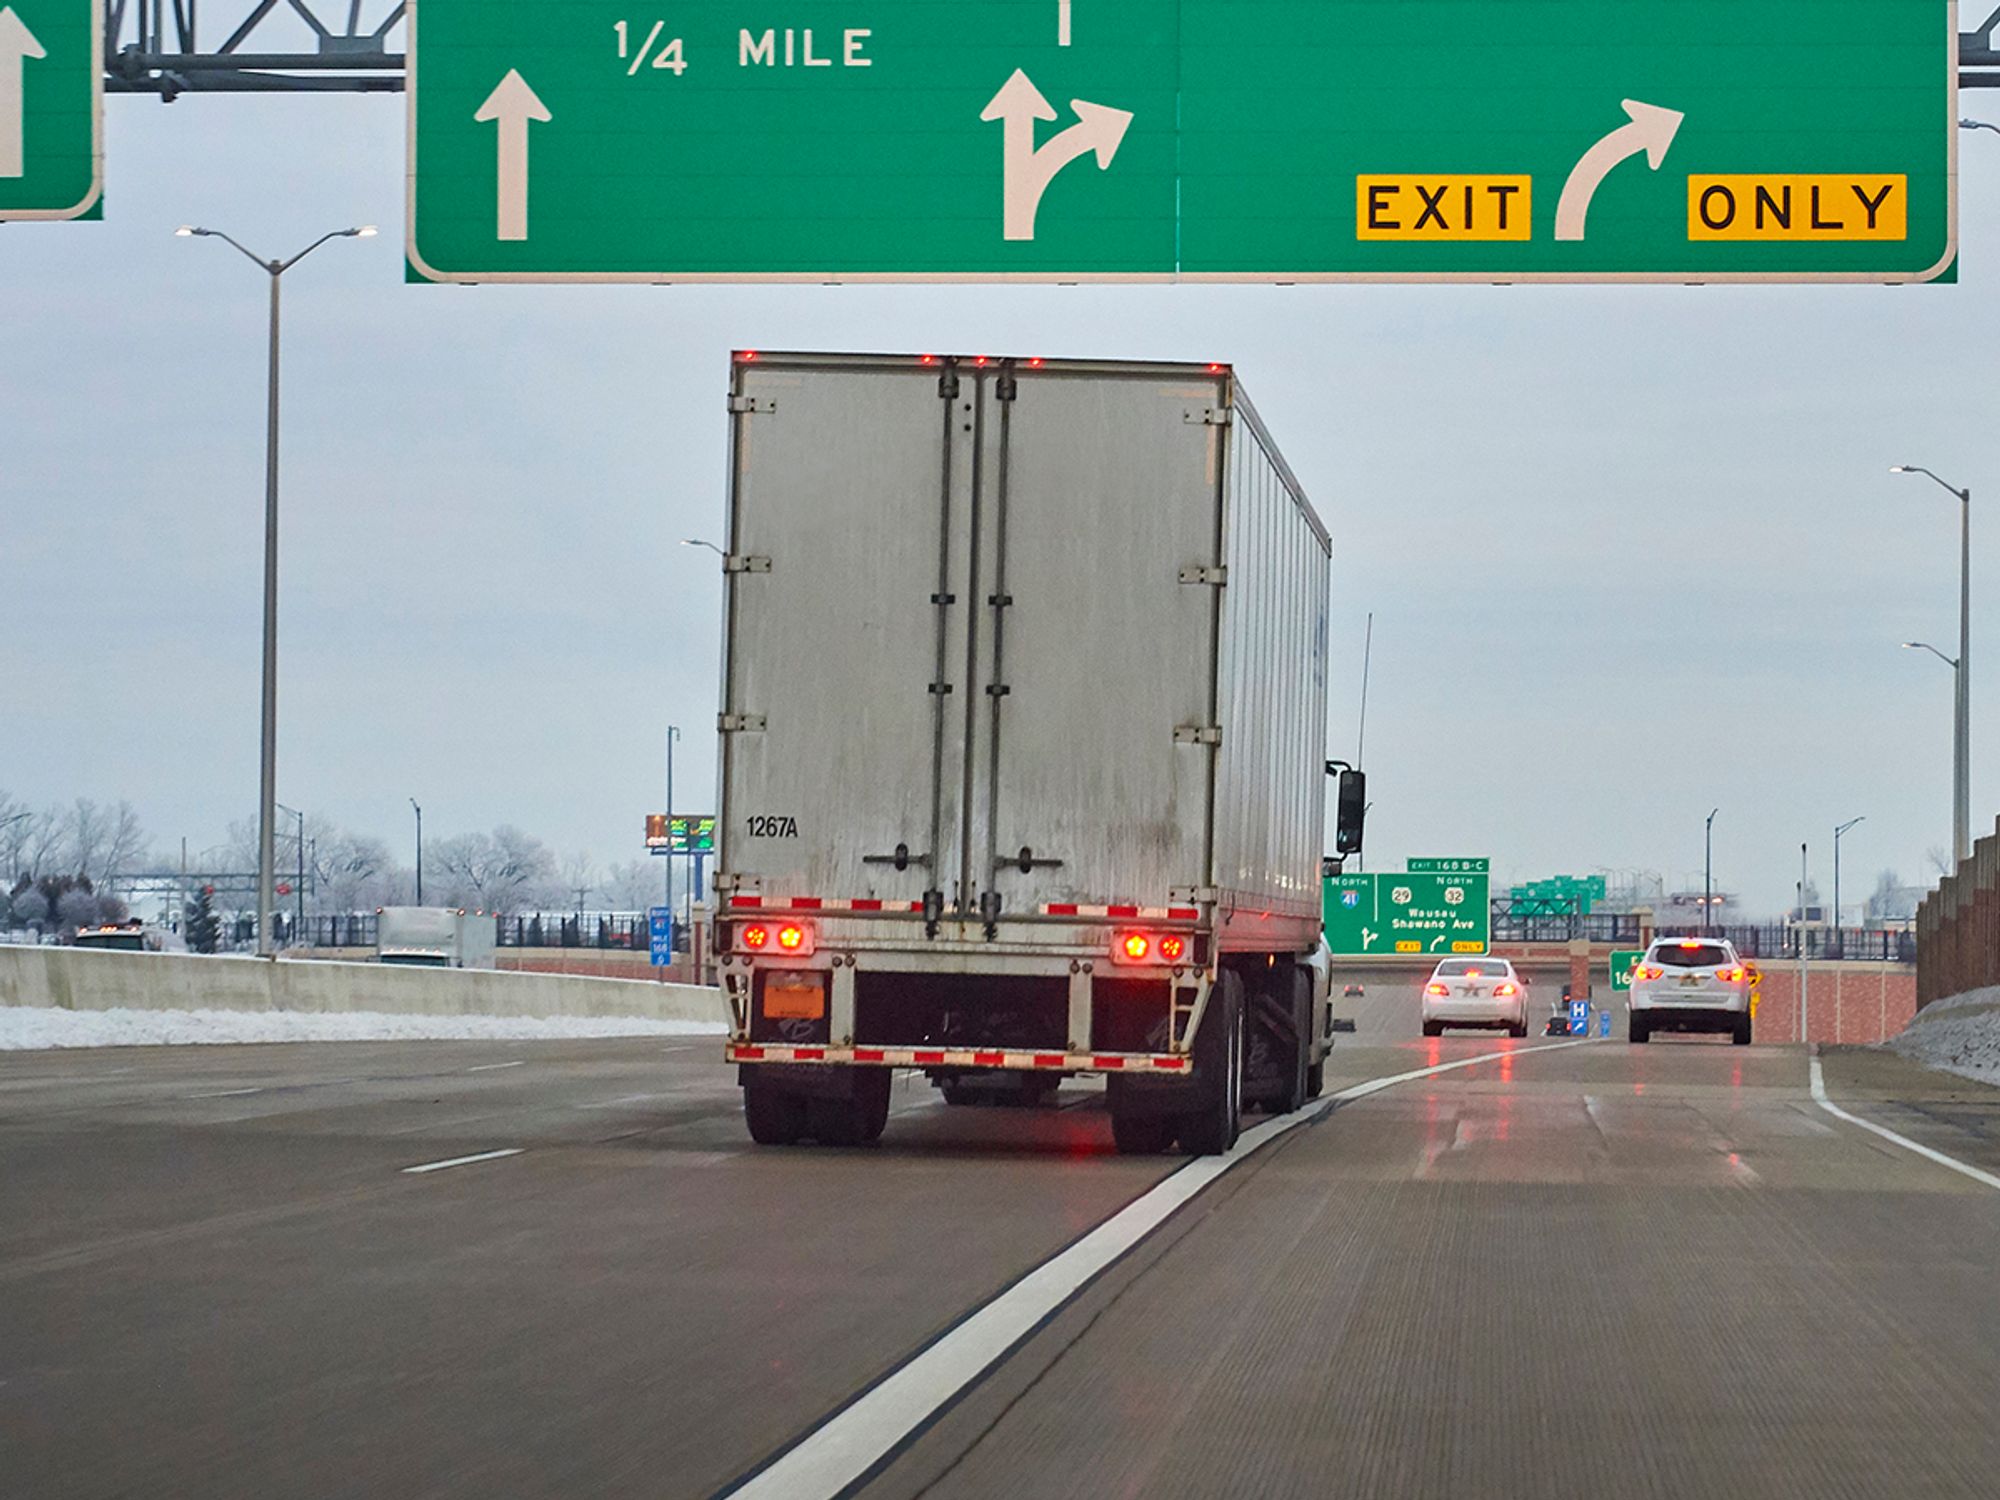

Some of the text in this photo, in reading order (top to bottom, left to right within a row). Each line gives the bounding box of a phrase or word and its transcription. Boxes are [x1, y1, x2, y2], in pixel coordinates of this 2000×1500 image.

[613, 20, 872, 75] 1/4 MILE
[1368, 184, 1893, 230] EXIT ONLY
[746, 816, 798, 838] 1267A
[1331, 877, 1368, 886] NORTH
[1436, 876, 1473, 885] NORTH
[1342, 894, 1357, 905] 41
[1394, 890, 1410, 902] 29
[1446, 890, 1462, 902] 32
[1408, 908, 1457, 918] Wausau
[1391, 919, 1474, 929] Shawano Ave
[1396, 942, 1482, 951] EXIT ONLY
[1573, 1002, 1585, 1017] H
